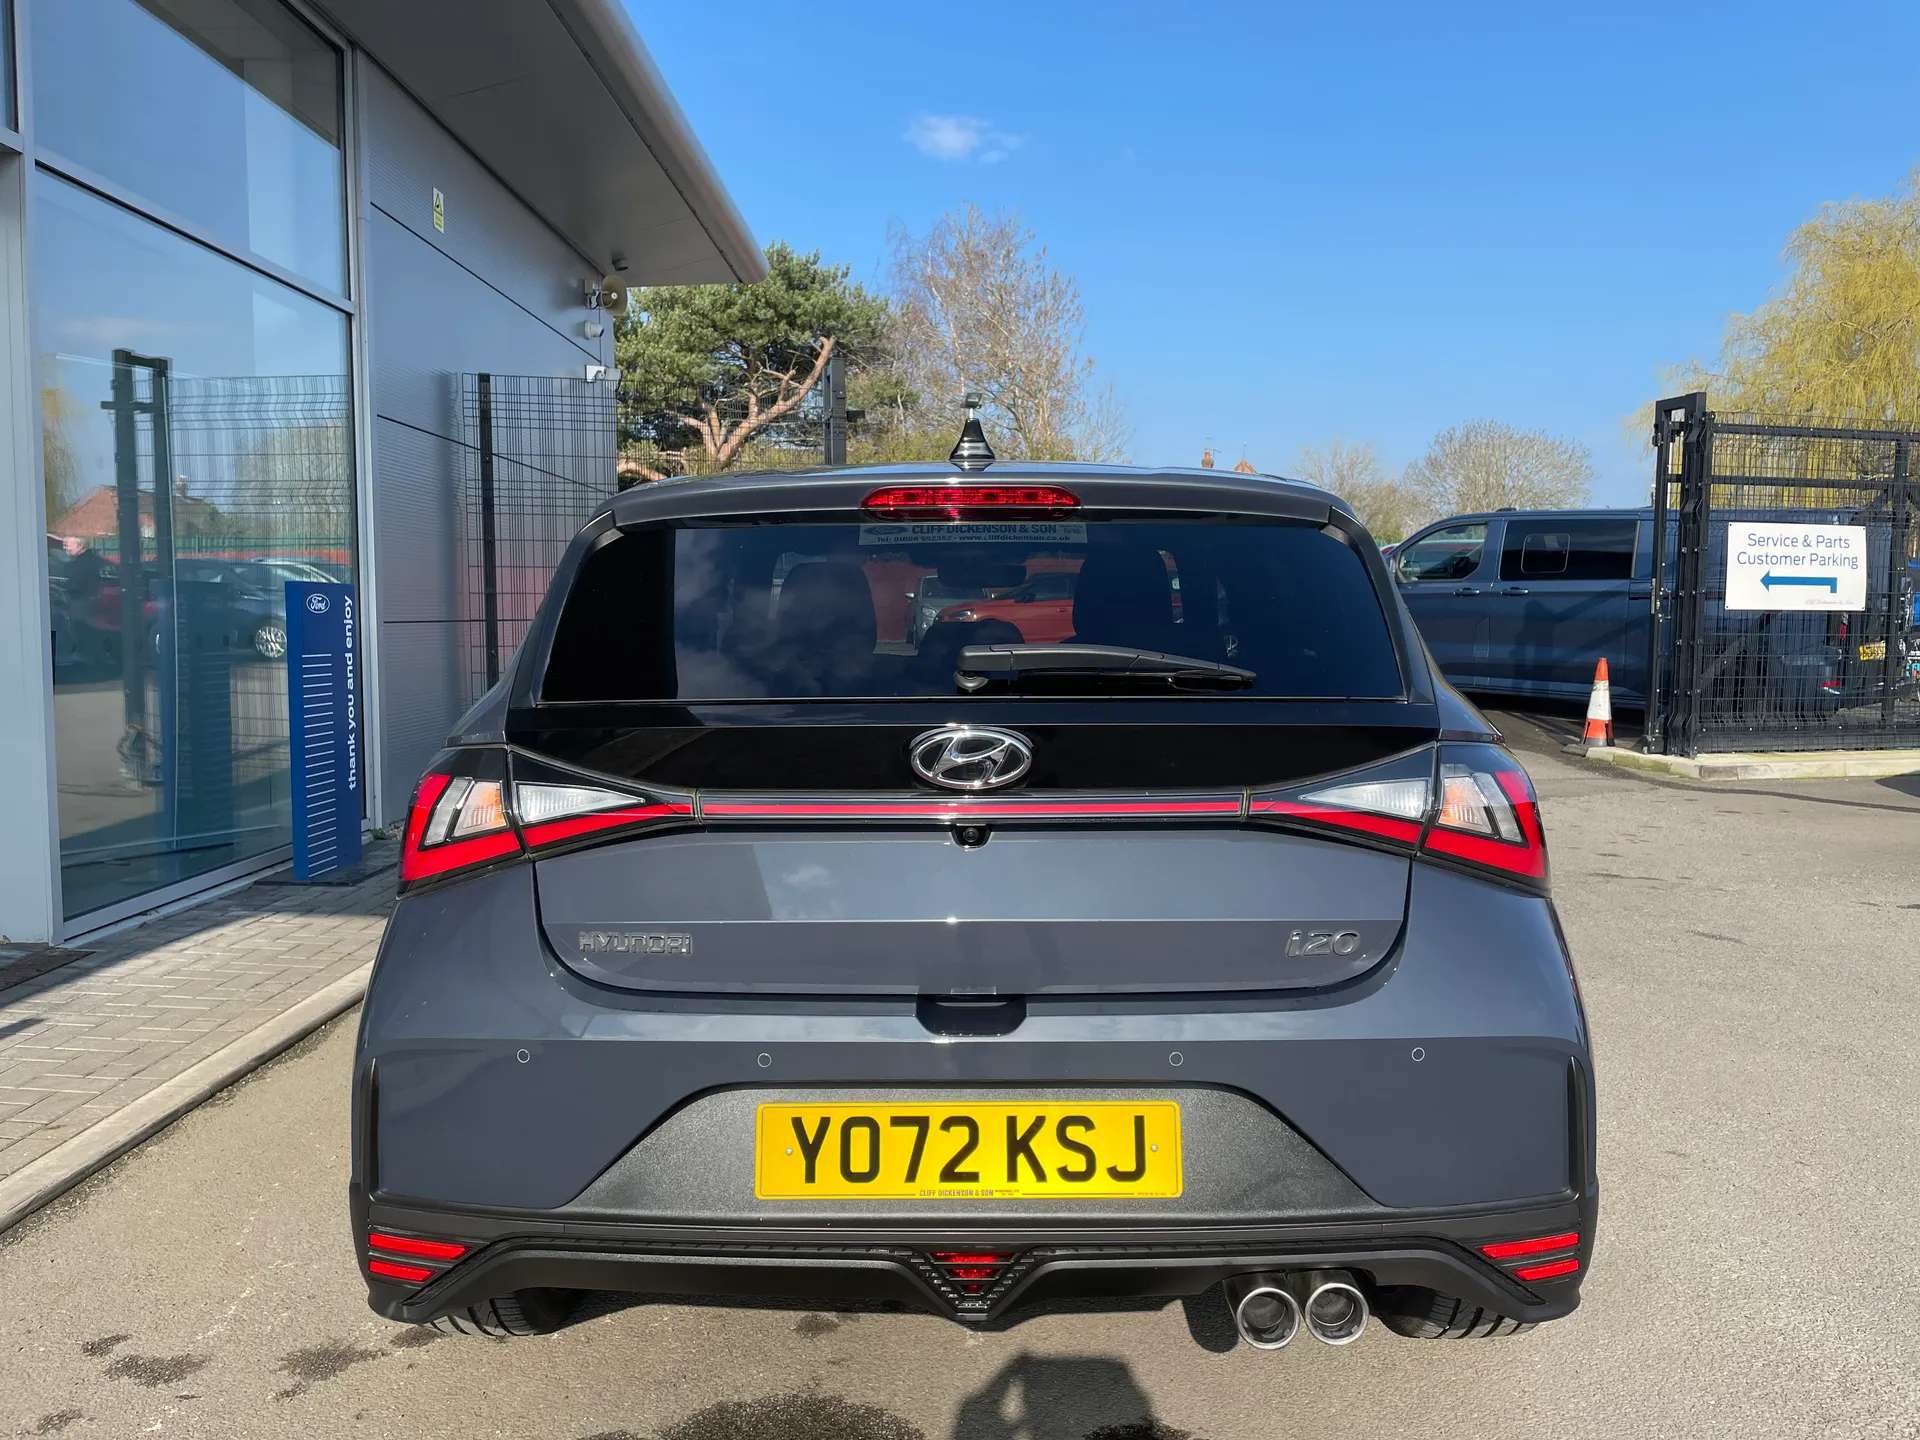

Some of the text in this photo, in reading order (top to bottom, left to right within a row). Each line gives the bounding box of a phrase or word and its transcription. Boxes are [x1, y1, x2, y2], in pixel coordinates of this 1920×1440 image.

[911, 524, 946, 534] CLIFF
[947, 524, 1017, 534] DICKENSON
[1018, 524, 1029, 534] &
[1031, 524, 1057, 534] SON
[1747, 533, 1850, 549] Service & Parts
[1737, 551, 1859, 570] Customer Parking
[310, 596, 327, 611] Ford
[343, 595, 357, 791] thank you and enjoy
[579, 933, 693, 954] HYUNDAI
[790, 1115, 1147, 1184] YO72 KSJ
[920, 1189, 937, 1197] CLIFF
